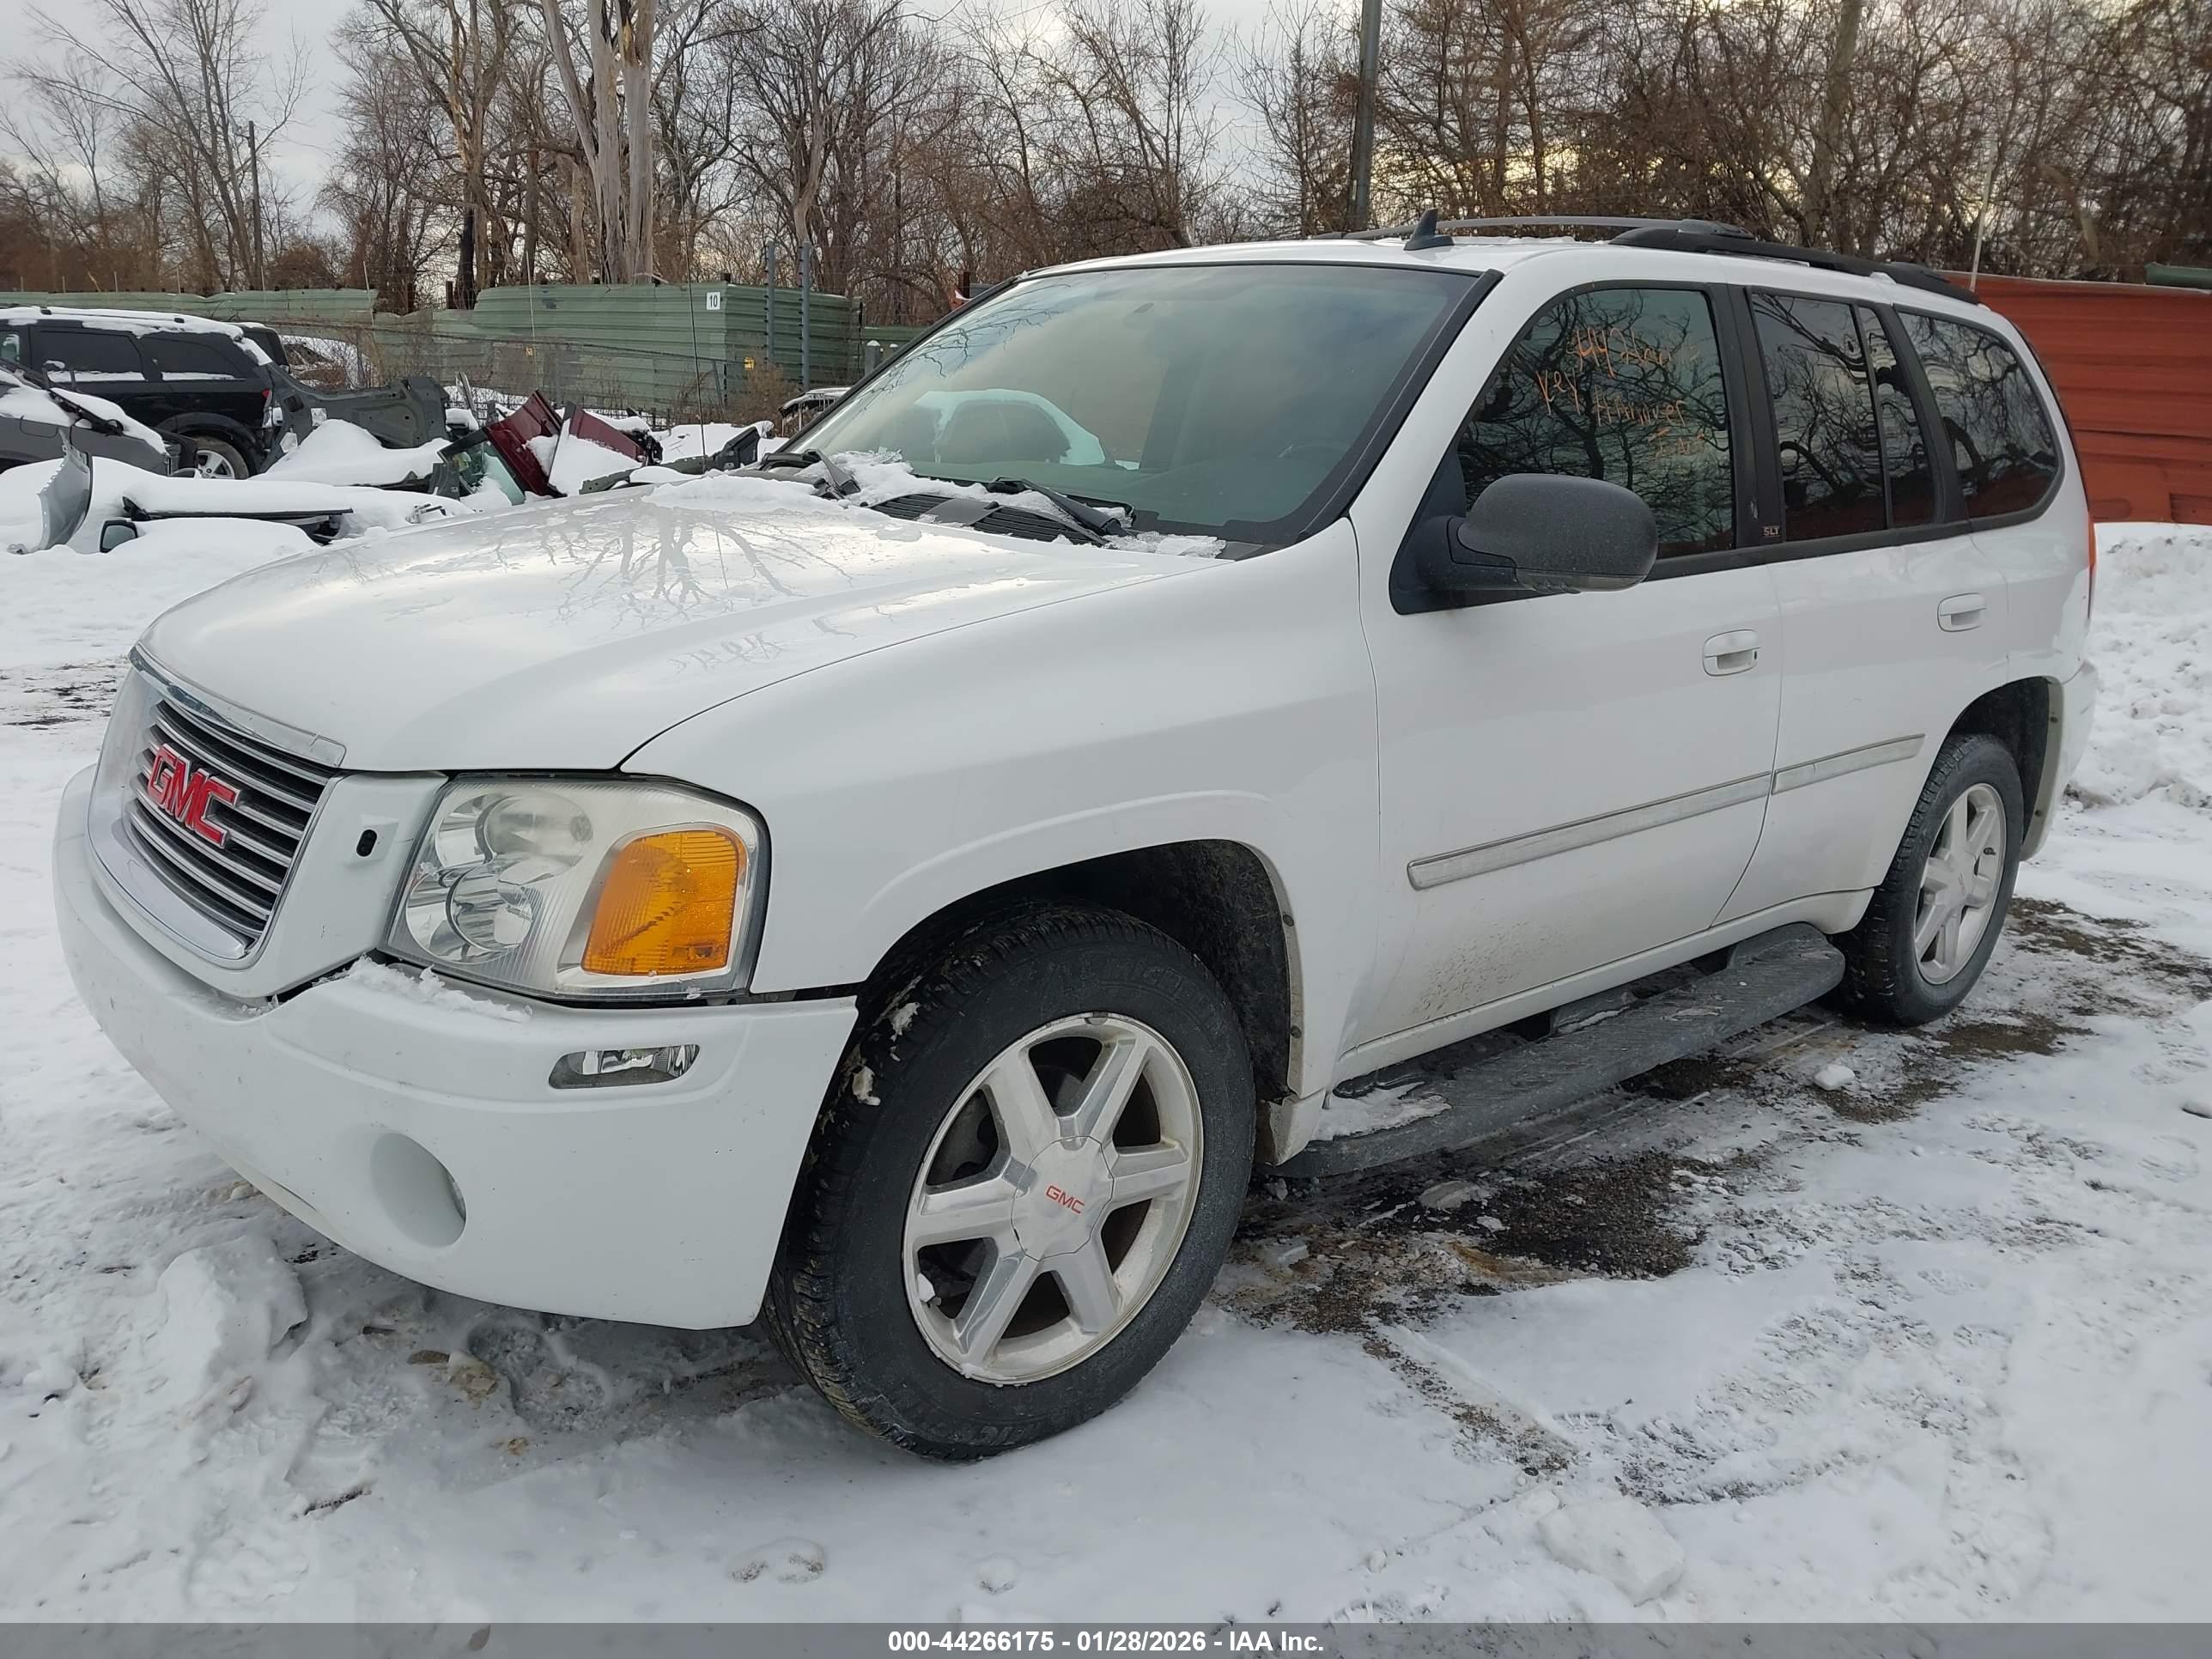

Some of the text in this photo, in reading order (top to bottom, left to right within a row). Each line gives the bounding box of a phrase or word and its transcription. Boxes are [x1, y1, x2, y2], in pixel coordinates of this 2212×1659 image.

[709, 295, 718, 307] 10
[1763, 526, 1780, 537] SLT
[148, 743, 240, 849] GMC
[1045, 1185, 1085, 1214] GMC
